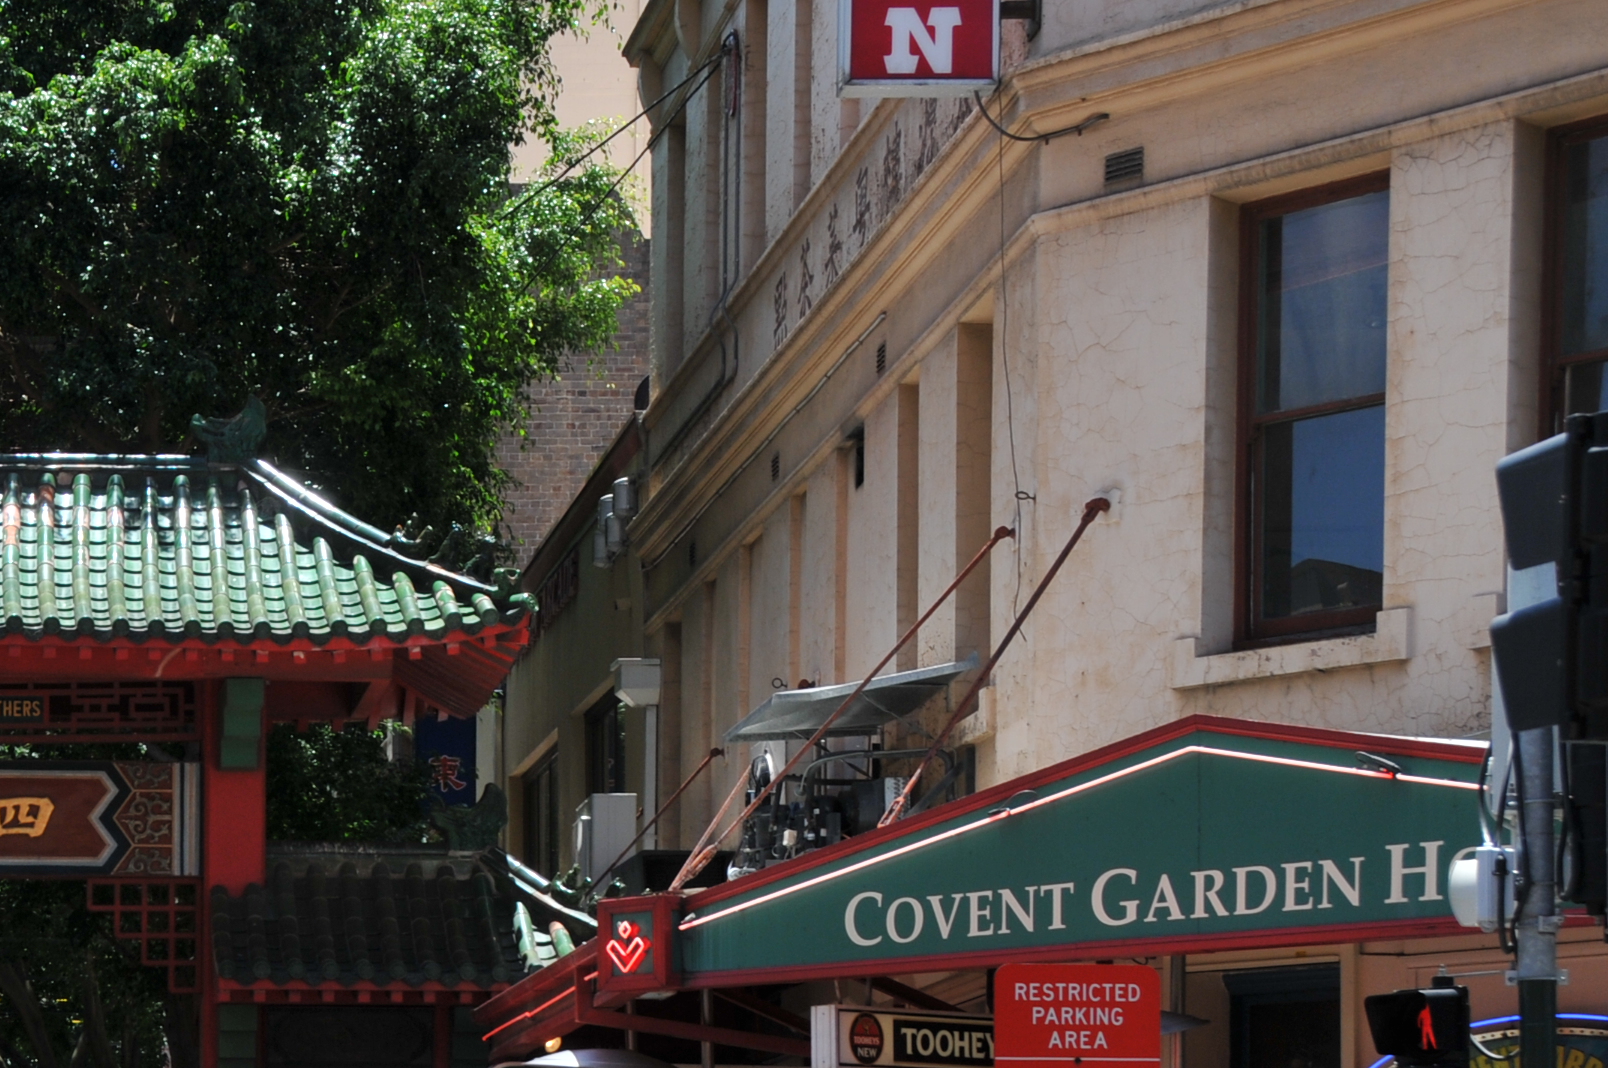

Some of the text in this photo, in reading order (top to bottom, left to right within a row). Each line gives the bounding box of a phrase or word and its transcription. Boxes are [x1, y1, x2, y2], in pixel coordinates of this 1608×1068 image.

[883, 6, 962, 74] N
[845, 882, 1074, 946] COVENT
[1092, 857, 1365, 926] GARDEN
[1014, 983, 1141, 1002] RESTRICTED
[1032, 1007, 1124, 1025] PARKING
[853, 1036, 880, 1045] TOOHEYS
[901, 1027, 995, 1059] TOOHEY
[1048, 1031, 1108, 1049] AREA
[857, 1047, 878, 1058] NEW
